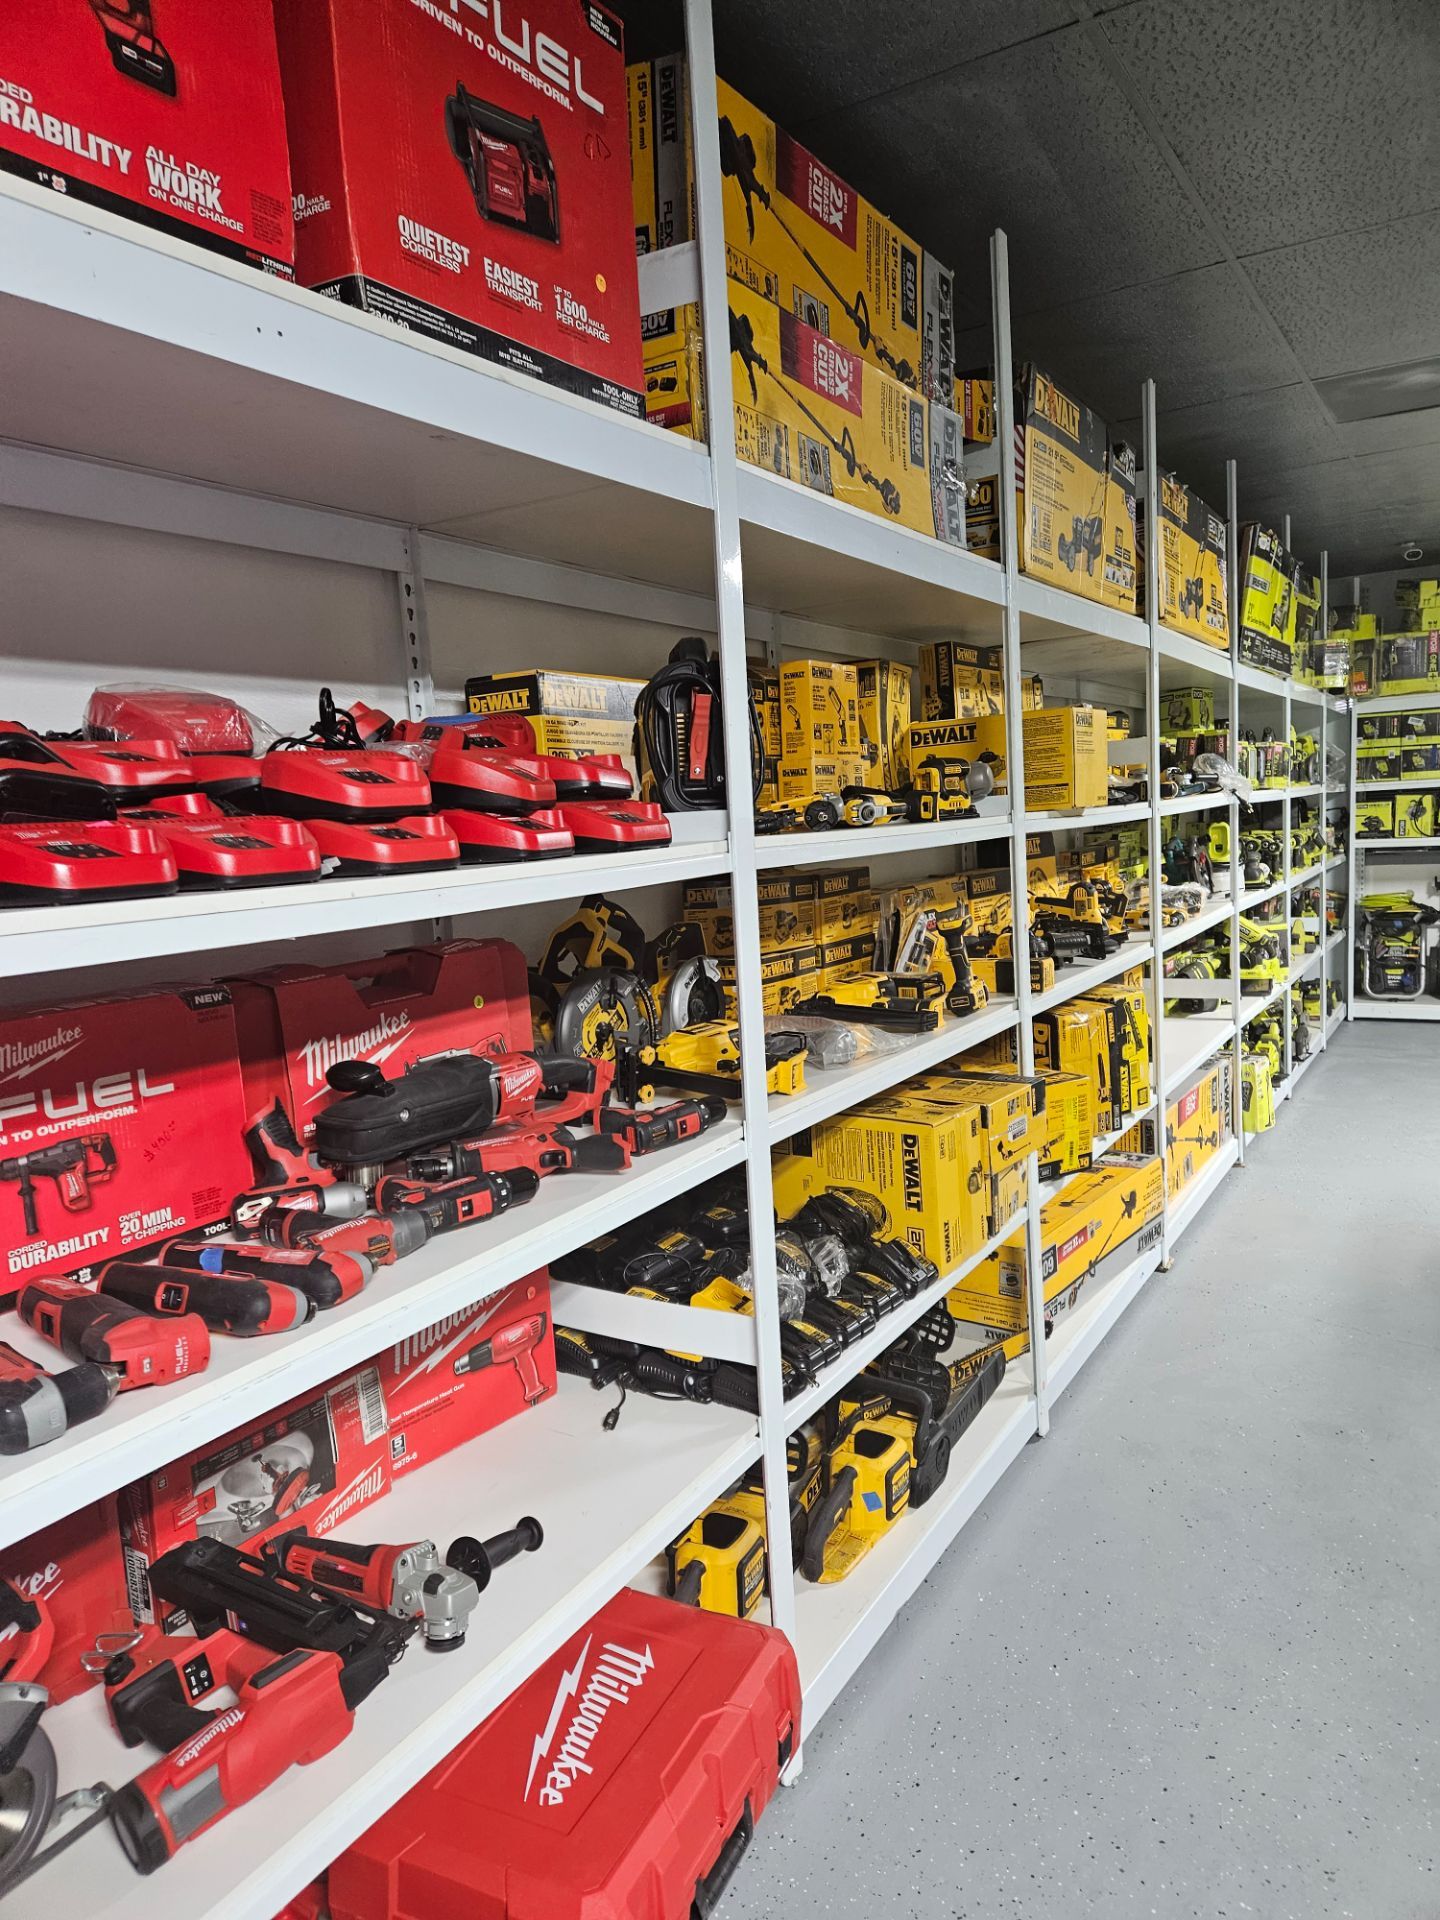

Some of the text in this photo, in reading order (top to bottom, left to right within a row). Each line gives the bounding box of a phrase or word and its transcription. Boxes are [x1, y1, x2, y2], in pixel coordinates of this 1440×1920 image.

[465, 26, 484, 51] TO
[487, 43, 574, 112] OUTPERFORM.
[659, 66, 677, 144] DEWALT
[145, 145, 221, 187] ALL DAY
[145, 157, 224, 214] WORK
[812, 167, 824, 218] CUT
[148, 186, 245, 234] ON ONE CHARGE
[294, 200, 331, 221] CHARGE
[829, 180, 843, 233] 2X
[398, 215, 470, 267] QUIETEST
[400, 235, 461, 274] CORDLESS
[483, 256, 539, 300] EASIEST
[553, 284, 572, 299] UP TO
[905, 261, 916, 318] 60V
[486, 276, 543, 312] TRANSPORT
[554, 294, 588, 322] 1,600
[556, 310, 611, 344] PER CHARGE
[818, 343, 829, 393] CUT
[834, 353, 849, 401] 2X
[602, 383, 639, 404] TOOL-ONLY
[784, 671, 805, 680] DEWALT
[812, 667, 833, 680] DEWALT
[469, 689, 530, 713] DEWALT
[544, 684, 607, 710] DEWALT
[911, 725, 976, 747] DEWALT
[783, 768, 807, 777] DEWALT
[815, 765, 836, 776] DEWALT
[758, 884, 790, 898] DEWALT
[824, 877, 849, 893] DEWALT
[973, 878, 996, 892] DEWALT
[763, 960, 793, 976] DEWALT
[826, 945, 852, 962] DEWALT
[194, 992, 223, 1005] NEW
[577, 981, 607, 1015] DEWALT
[296, 1008, 410, 1087] Milwaukee
[504, 1068, 537, 1094] Milwaukee
[11, 1130, 33, 1142] TO
[36, 1105, 138, 1137] OUTPERFORM.
[903, 1133, 922, 1211] DEWALT
[119, 1211, 141, 1223] OVER
[120, 1207, 172, 1236] 20 MIN
[121, 1217, 186, 1245] OF CHIPPING
[318, 1217, 368, 1241] Milwaukee
[8, 1240, 48, 1258] CORDED
[8, 1228, 109, 1273] DURABILITY
[403, 1396, 438, 1416] Temperature
[439, 1390, 453, 1399] Heat
[453, 1384, 465, 1392] Gun
[863, 1398, 892, 1421] DEWALT
[315, 1466, 386, 1534] Milwaukee
[175, 1708, 246, 1768] Milwaukee
[540, 1642, 655, 1806] Milwaukee
